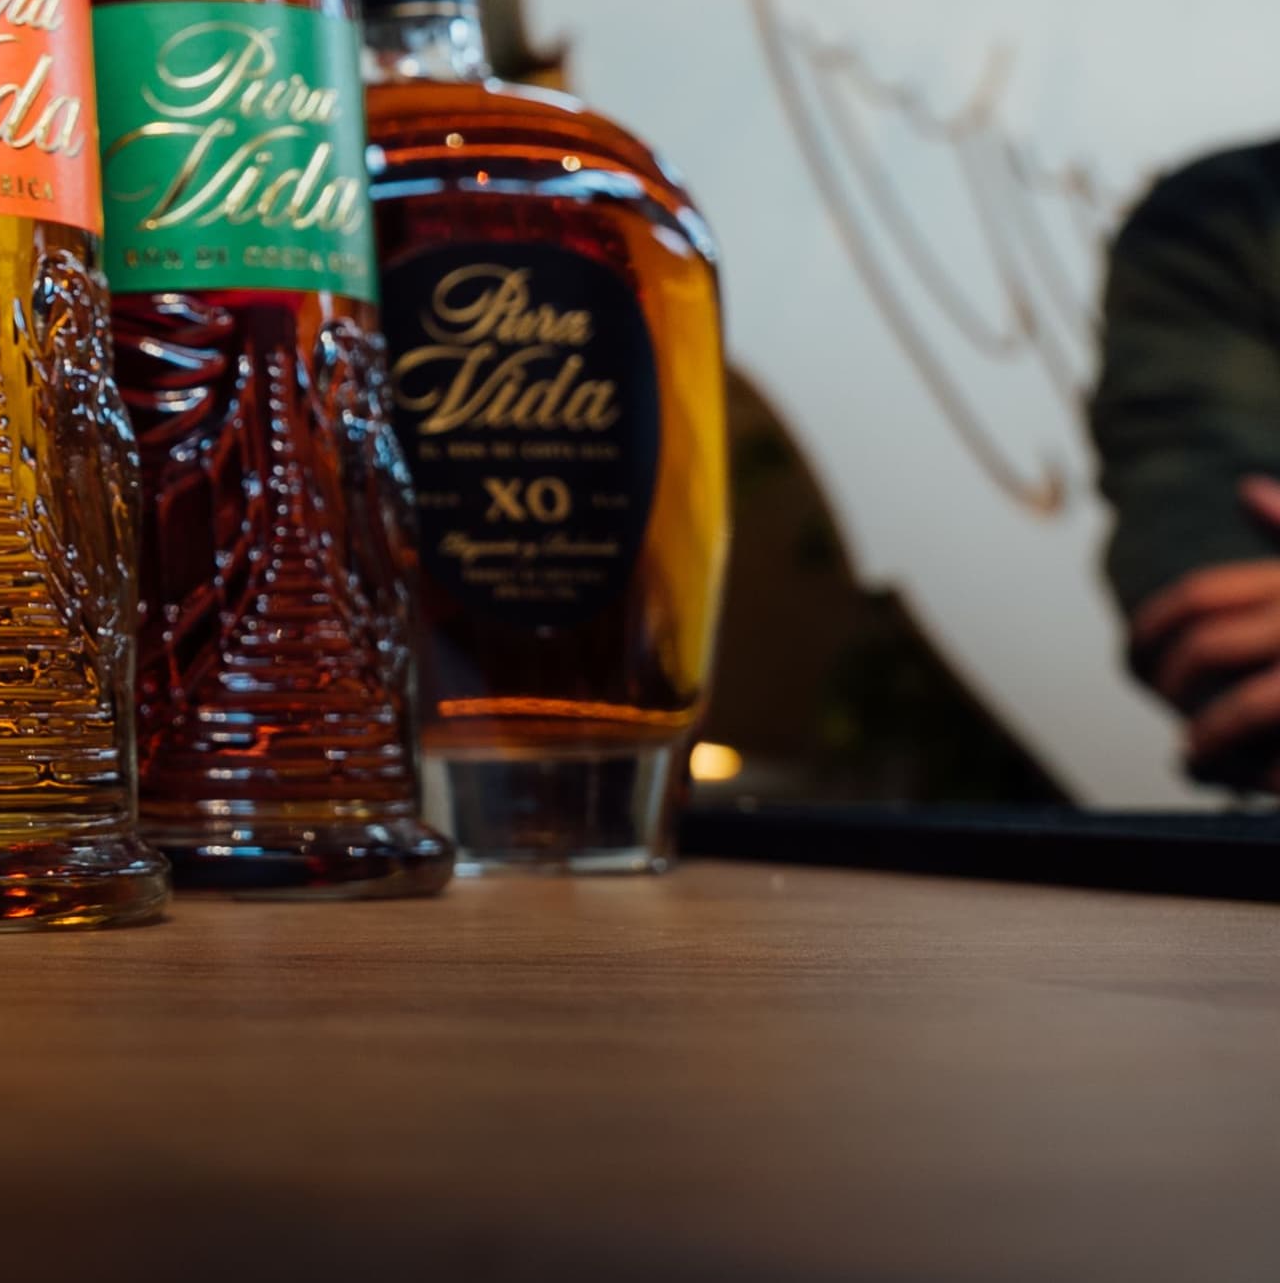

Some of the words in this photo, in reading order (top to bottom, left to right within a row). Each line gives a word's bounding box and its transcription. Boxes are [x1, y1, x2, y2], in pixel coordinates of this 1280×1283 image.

[142, 20, 341, 124] Pura
[0, 175, 55, 202] RICA
[103, 117, 365, 236] Vida
[420, 263, 594, 347] Pura
[392, 342, 623, 435] Vida
[481, 475, 572, 524] XO
